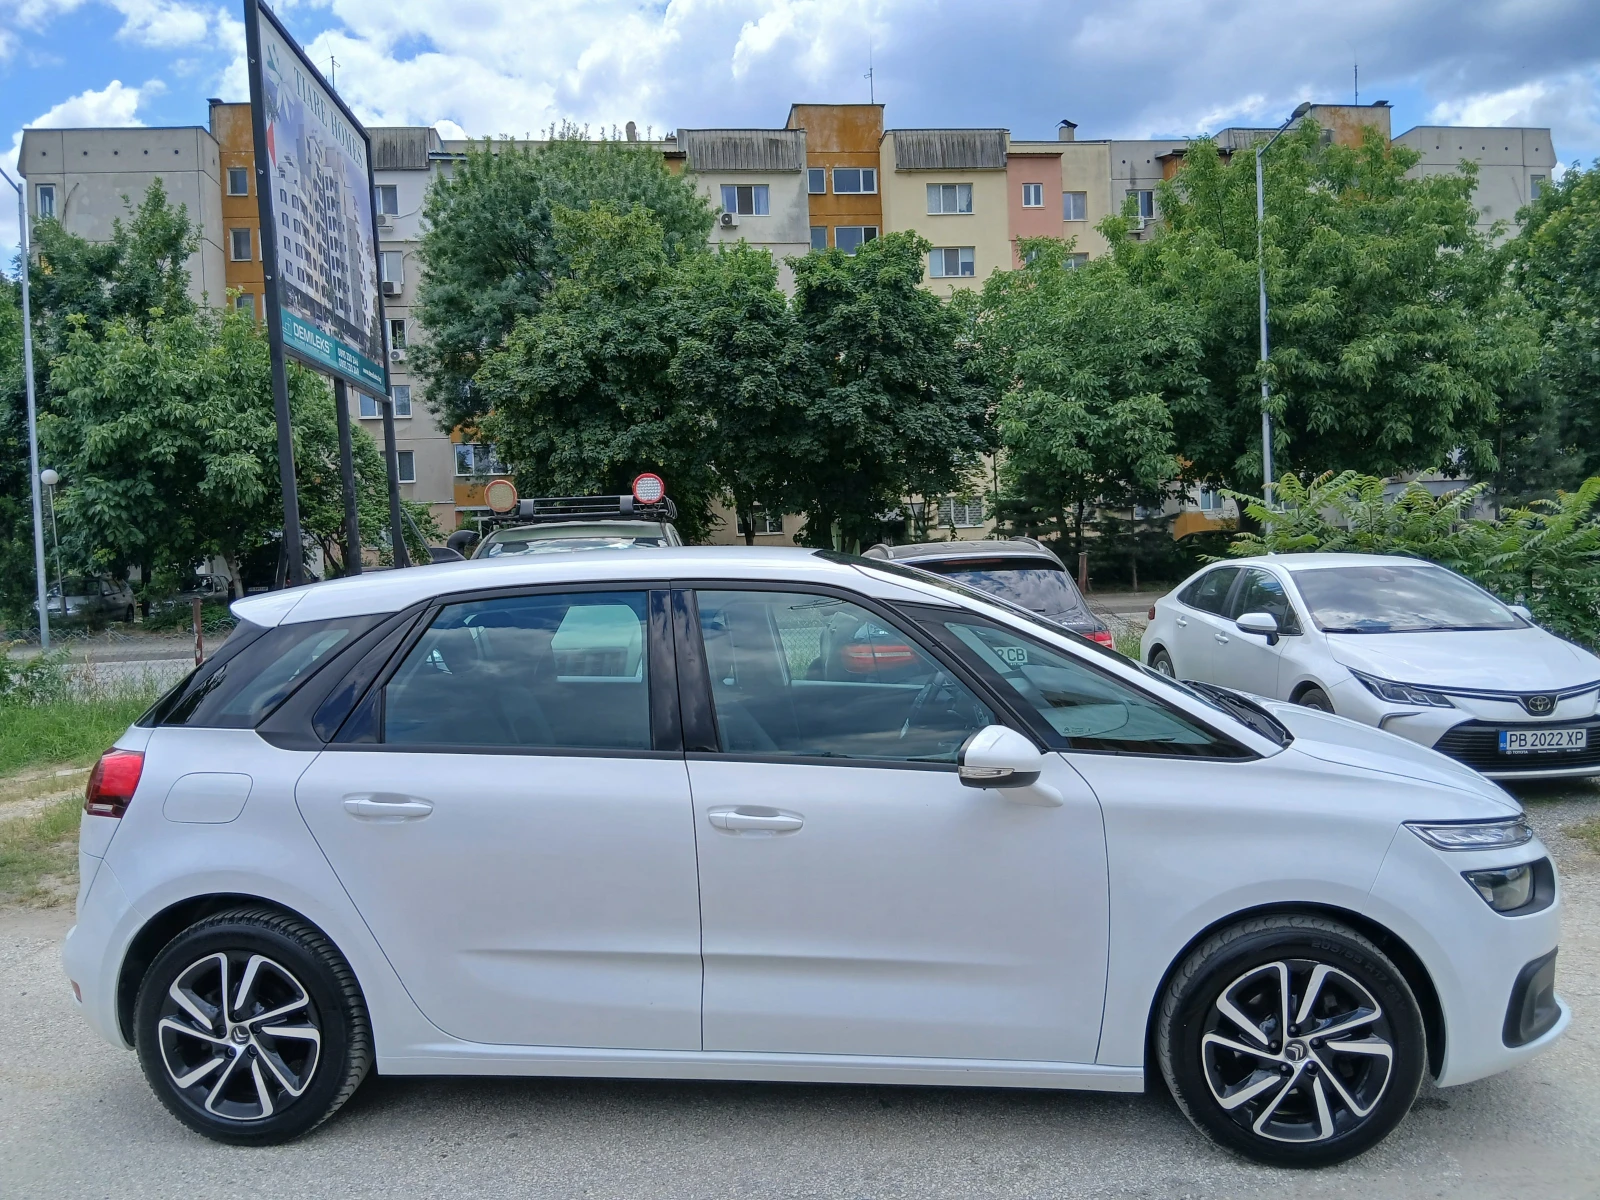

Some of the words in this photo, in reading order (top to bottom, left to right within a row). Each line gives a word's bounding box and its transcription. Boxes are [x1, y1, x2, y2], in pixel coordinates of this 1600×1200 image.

[293, 66, 328, 128] TIARE
[330, 109, 363, 169] HOMES
[293, 322, 330, 354] DEMILEKS
[1007, 648, 1026, 662] CB
[1509, 733, 1527, 748] PB
[1530, 732, 1564, 747] 2022
[1566, 731, 1584, 746] XP
